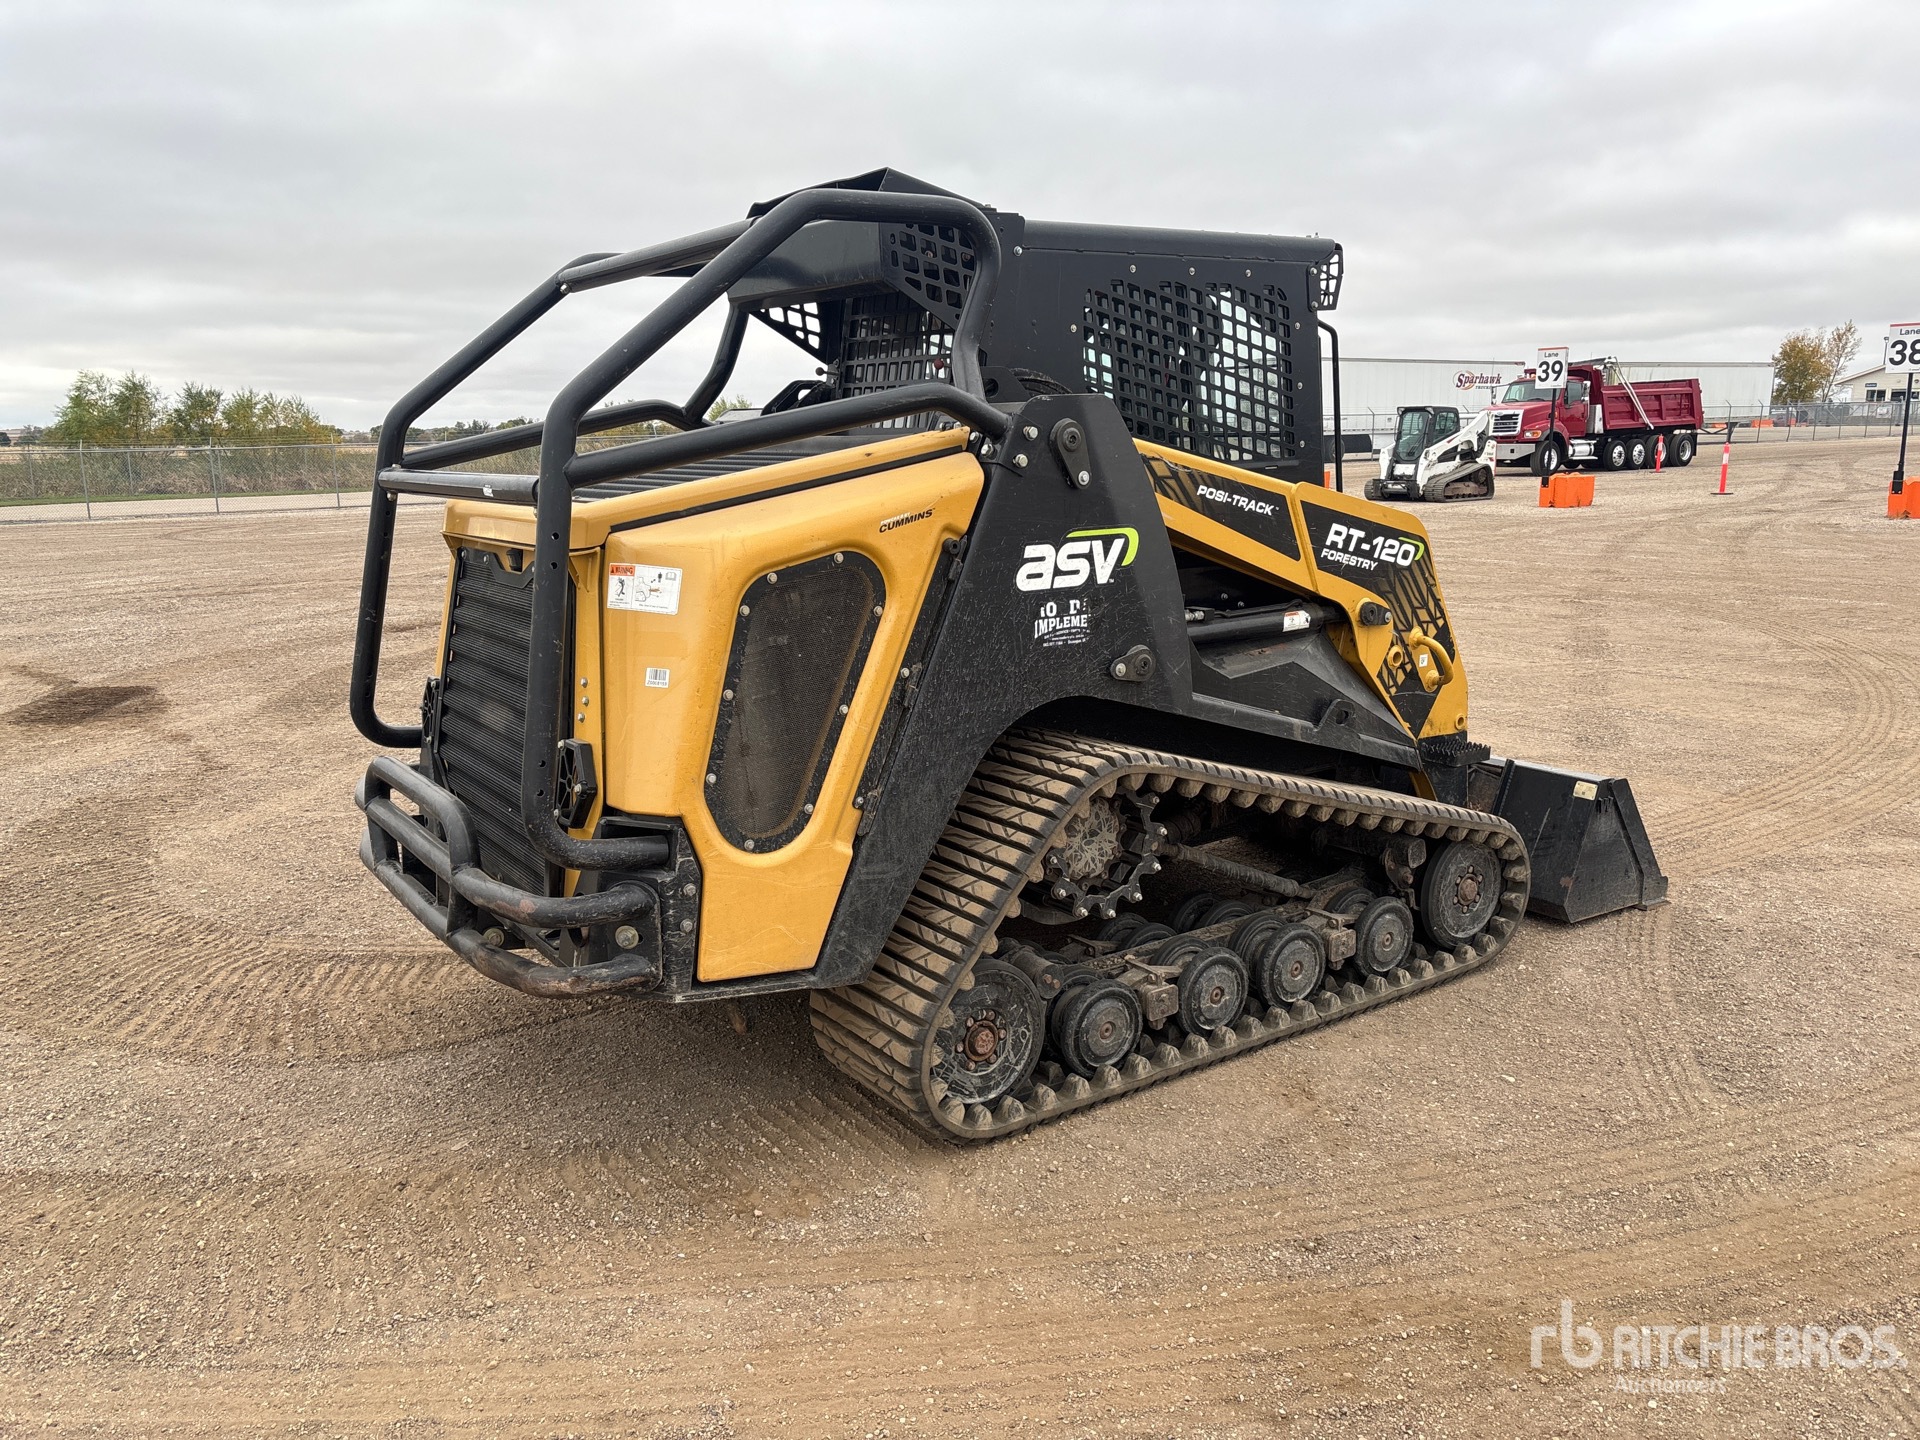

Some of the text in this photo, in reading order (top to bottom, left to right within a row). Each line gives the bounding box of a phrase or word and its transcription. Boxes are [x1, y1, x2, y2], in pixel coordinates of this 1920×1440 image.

[1889, 338, 1920, 366] 38
[1455, 373, 1502, 388] Sparhawk
[1537, 360, 1564, 382] 39
[1196, 484, 1275, 515] POSI-TRACK
[879, 509, 933, 533] CUMMINS
[1325, 522, 1416, 567] RT-120
[1320, 548, 1379, 571] FORESTRY
